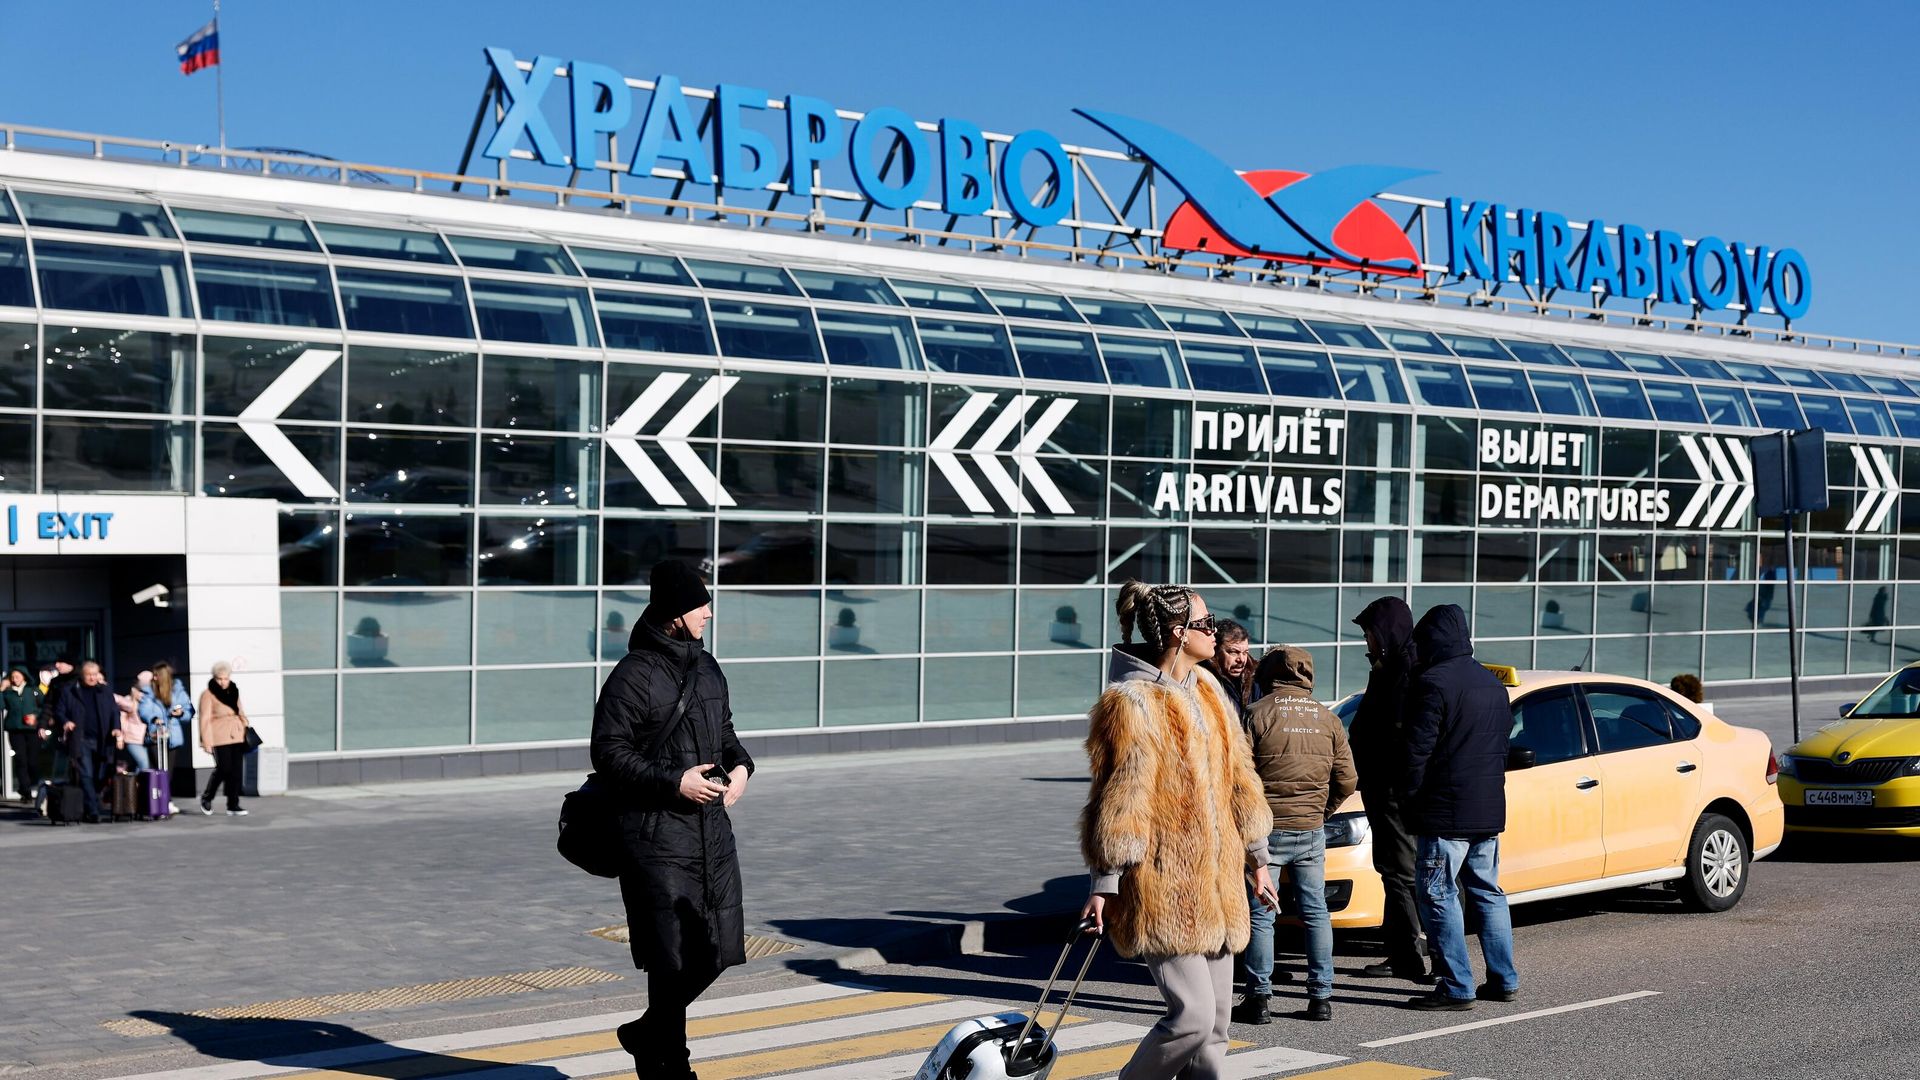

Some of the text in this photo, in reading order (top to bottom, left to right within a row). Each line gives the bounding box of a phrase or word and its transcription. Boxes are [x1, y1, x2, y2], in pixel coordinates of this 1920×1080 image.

[483, 46, 1075, 228] ХРАБРОВО
[1446, 196, 1812, 320] KHRABROVO
[1193, 408, 1345, 456] ПРИЛЁТ
[1481, 428, 1586, 467] ВЫЛЕТ
[1153, 472, 1342, 516] ARRIVALS
[1480, 483, 1670, 522] DEPARTURES
[38, 512, 114, 539] EXIT
[1274, 695, 1318, 705] Exploration
[1856, 791, 1869, 801] 39
